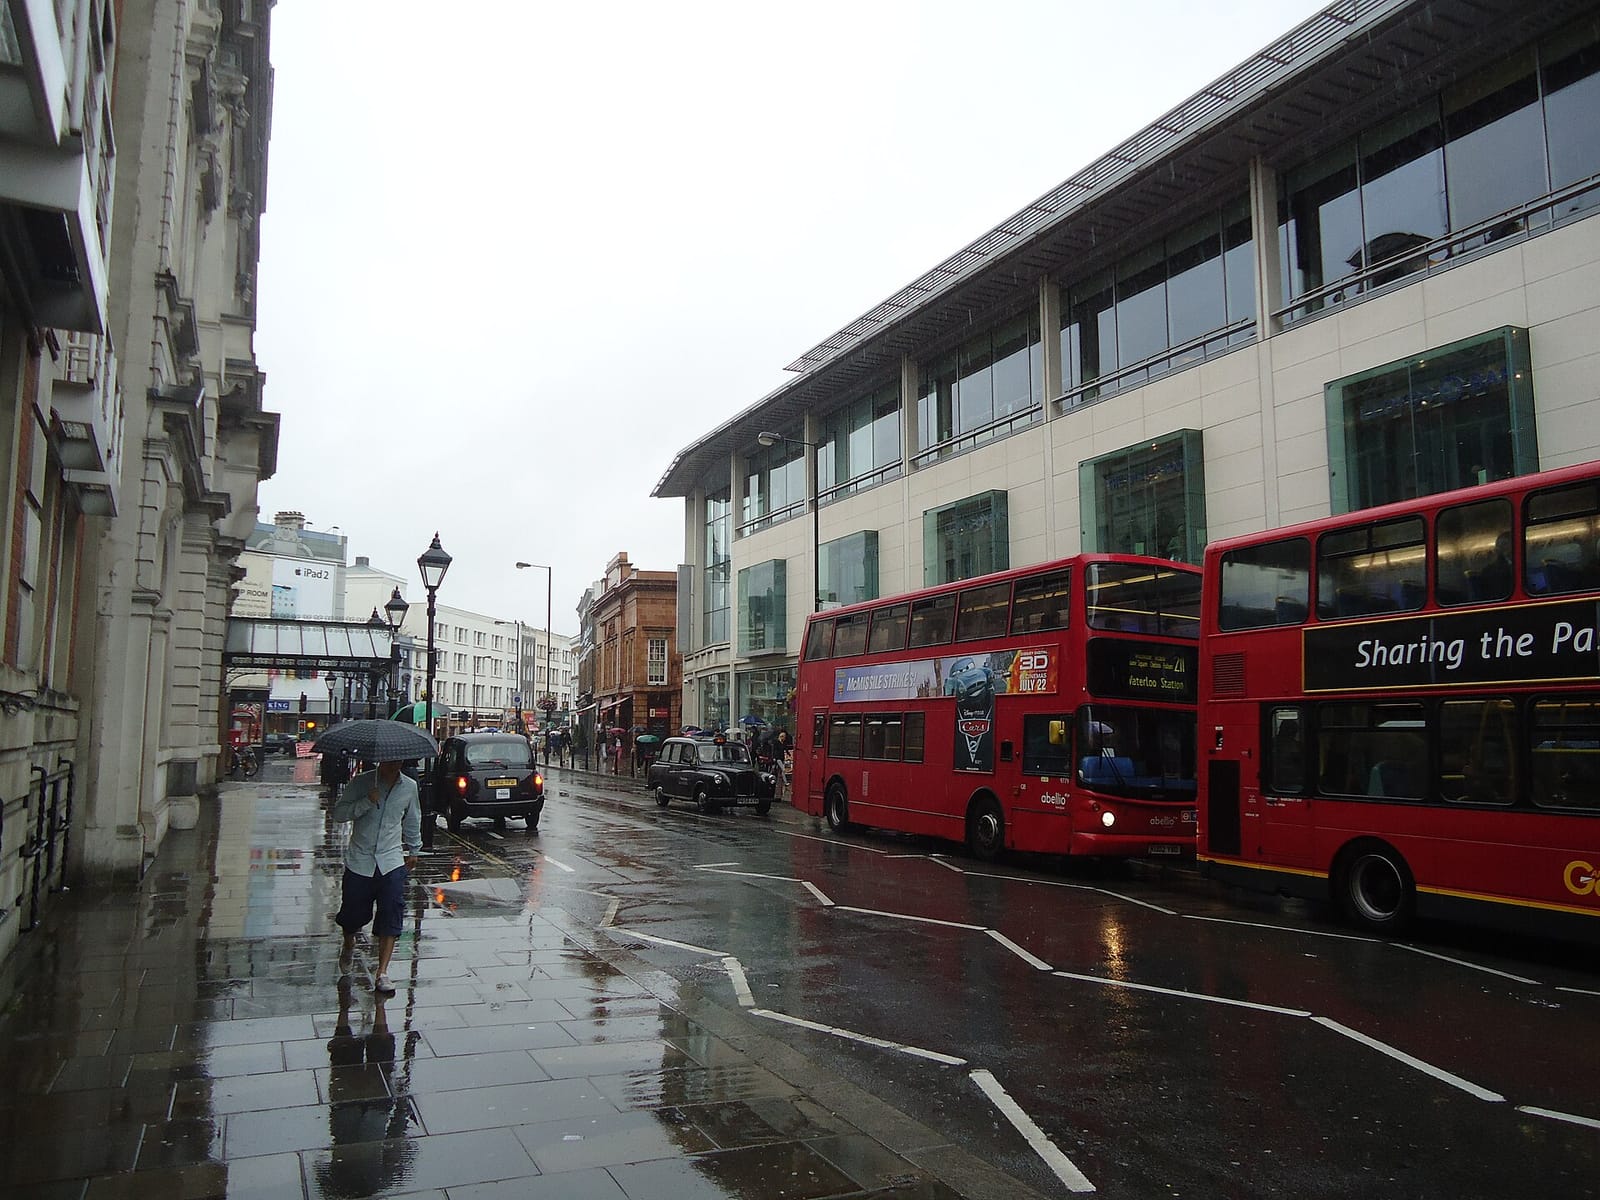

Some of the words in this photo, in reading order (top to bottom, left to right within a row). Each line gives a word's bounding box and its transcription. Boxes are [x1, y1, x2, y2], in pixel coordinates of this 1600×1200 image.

[304, 567, 323, 578] iPad
[324, 571, 329, 579] 2
[247, 589, 268, 597] ROOM
[1355, 635, 1464, 670] Sharing
[1480, 628, 1534, 659] the
[1552, 621, 1600, 654] Pa
[1020, 655, 1048, 670] 3D
[884, 671, 917, 689] STRIKES!
[1019, 679, 1035, 691] JULY
[1037, 678, 1047, 691] 22
[1160, 677, 1185, 690] Station
[962, 721, 986, 731] Cars
[1041, 792, 1066, 805] abellio
